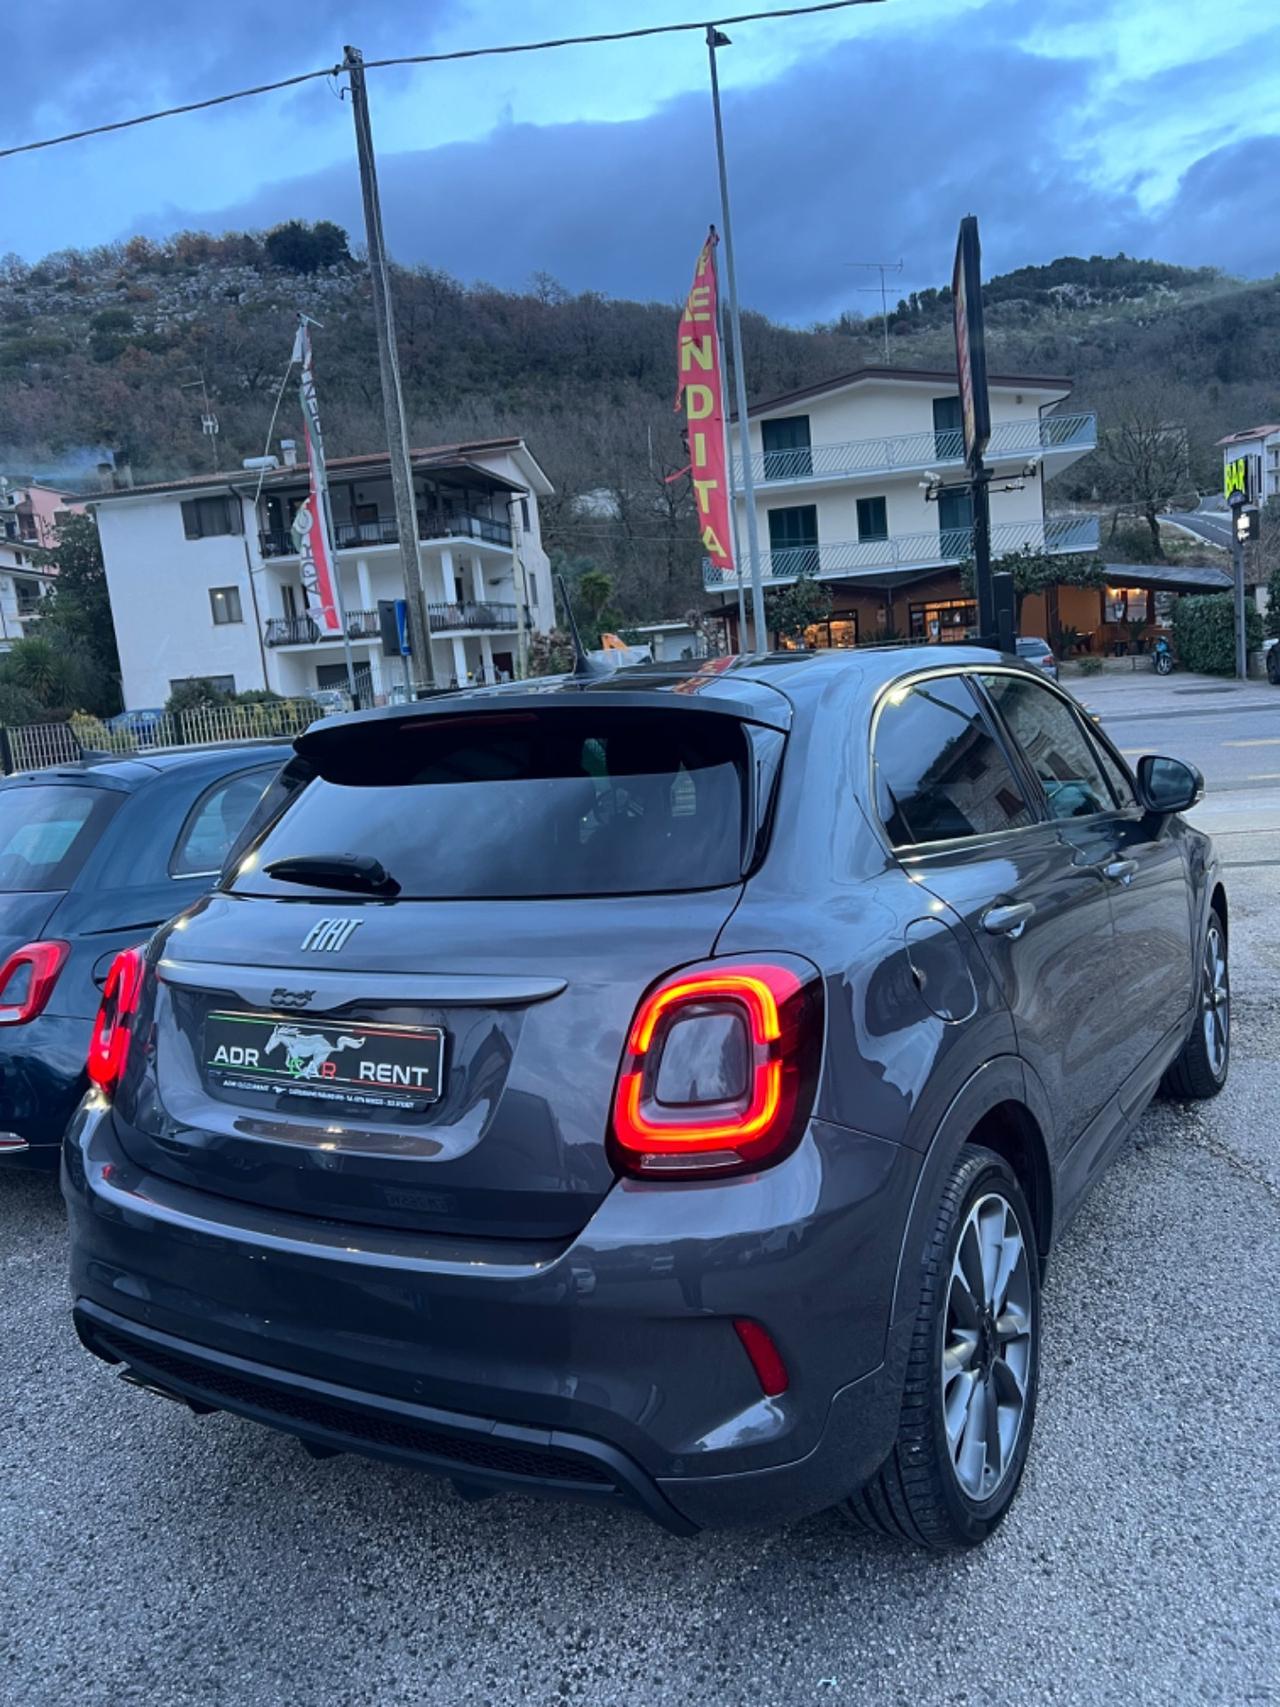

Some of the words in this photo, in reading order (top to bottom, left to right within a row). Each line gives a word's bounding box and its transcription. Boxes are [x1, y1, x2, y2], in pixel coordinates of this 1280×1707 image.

[1224, 458, 1245, 500] BAR
[300, 918, 365, 953] FIAT
[214, 1045, 260, 1067] ADR
[359, 1061, 429, 1087] RENT
